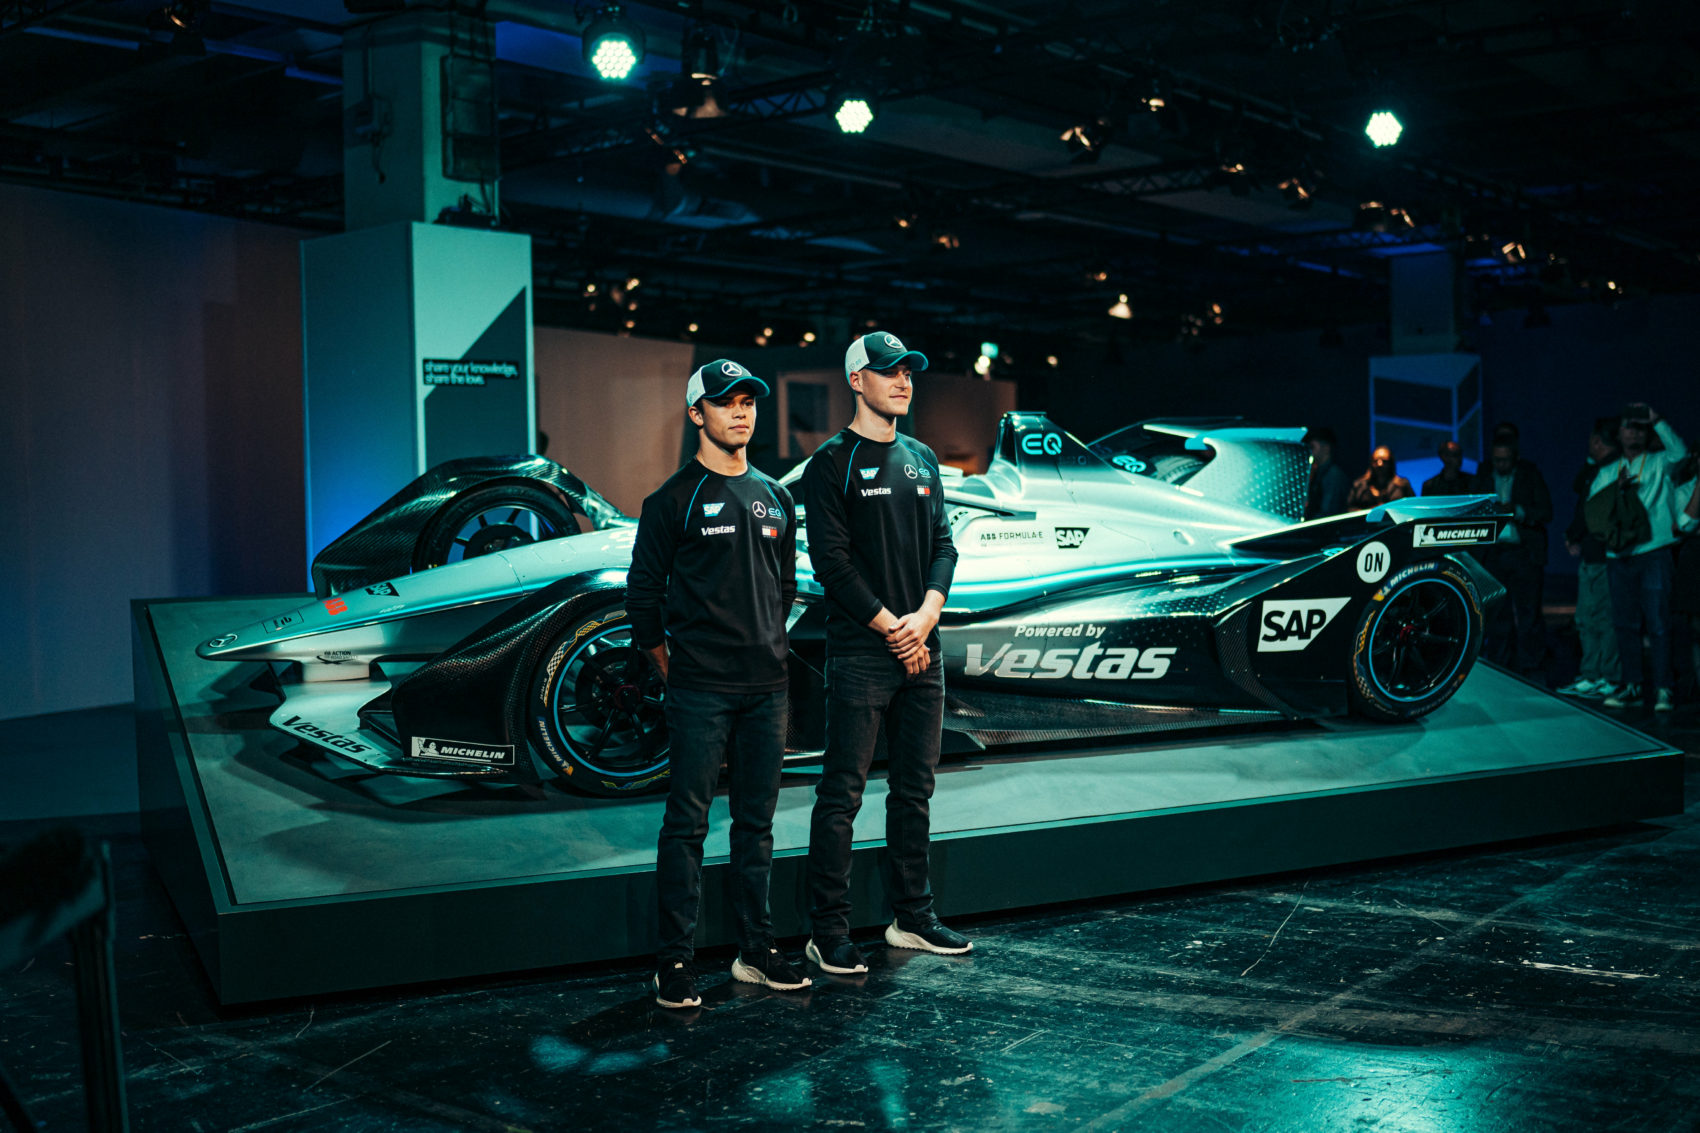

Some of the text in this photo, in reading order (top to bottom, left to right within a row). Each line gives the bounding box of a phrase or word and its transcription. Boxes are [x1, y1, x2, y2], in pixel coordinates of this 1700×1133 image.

[1021, 432, 1063, 456] EQ
[1112, 455, 1147, 473] EQ
[861, 487, 892, 497] Vestas
[703, 505, 722, 515] SAP
[768, 507, 782, 517] EQ
[701, 525, 736, 537] Vestas
[980, 533, 997, 541] ABB
[1055, 530, 1084, 546] SAP
[1436, 528, 1489, 540] MICHELIN
[1364, 552, 1384, 573] ON
[1390, 561, 1436, 587] MICHELIN
[1014, 624, 1107, 638] Powered by
[1261, 608, 1327, 643] SAP
[964, 641, 1178, 680] Vestas
[282, 715, 373, 754] Vestas
[538, 720, 563, 762] MICHELIN
[440, 746, 506, 759] MICHELIN
